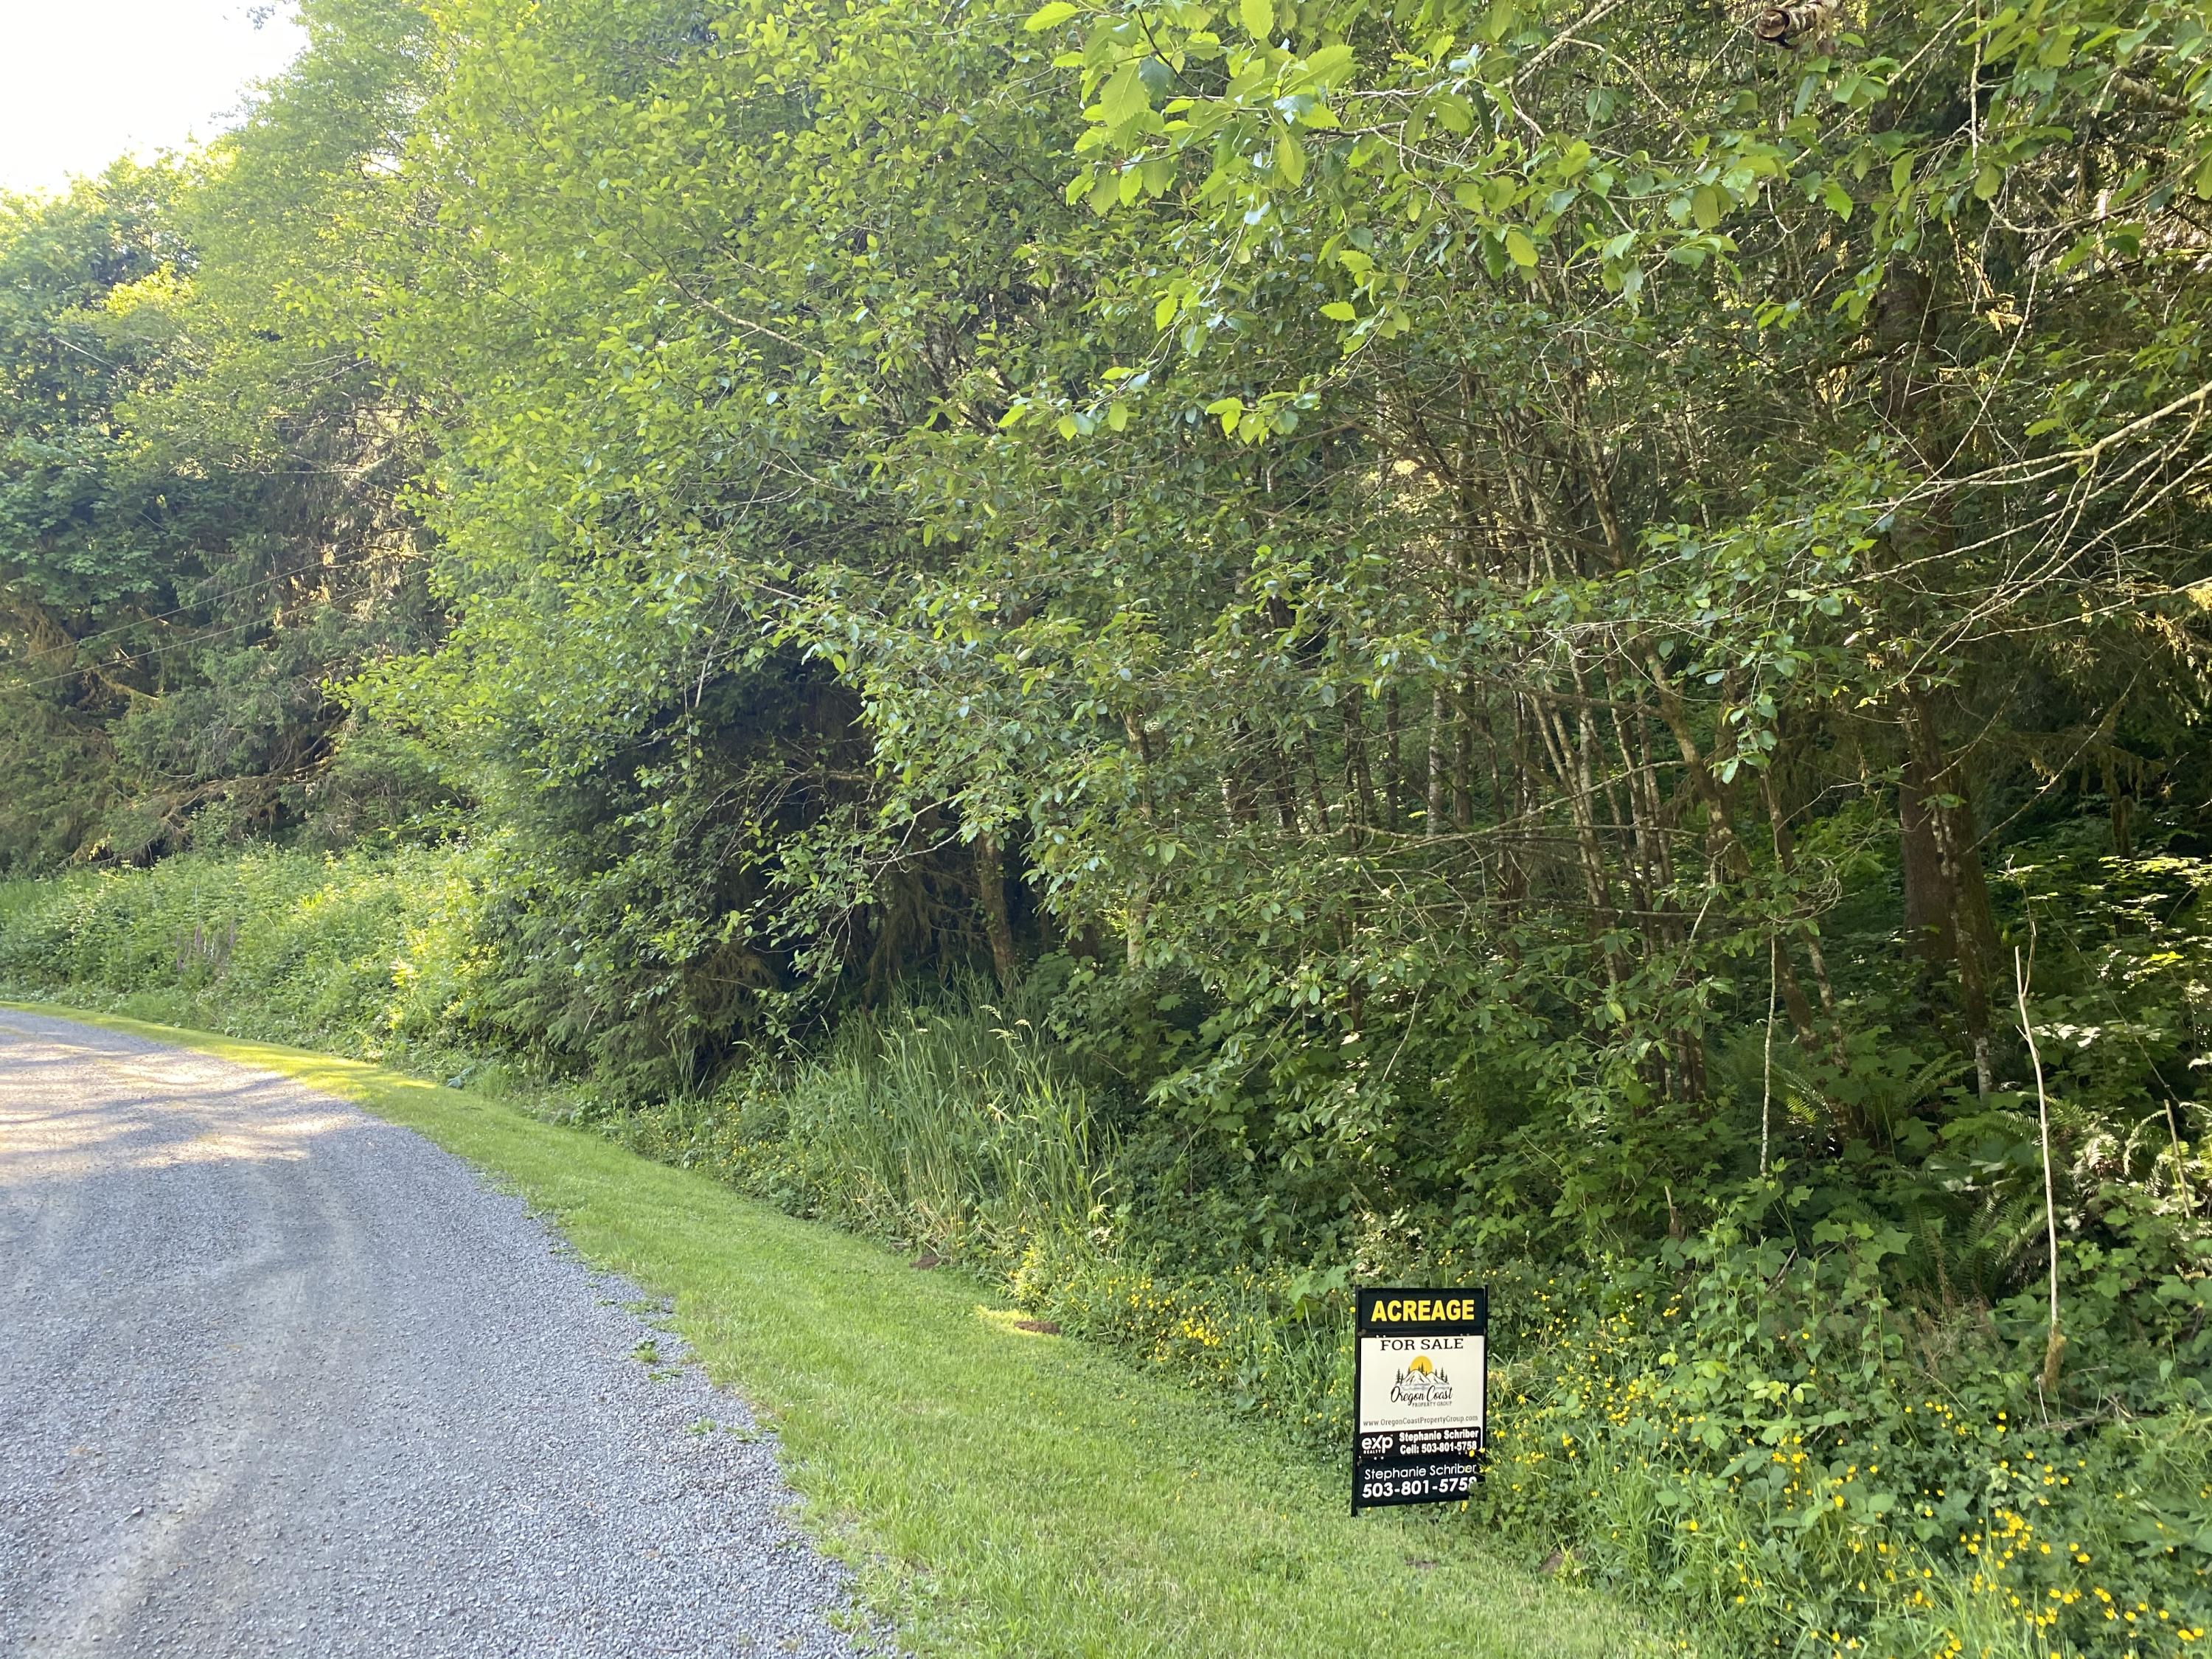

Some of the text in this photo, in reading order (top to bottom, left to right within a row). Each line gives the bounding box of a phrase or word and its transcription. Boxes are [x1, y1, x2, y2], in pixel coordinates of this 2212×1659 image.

[1371, 1300, 1475, 1322] ACREAGE
[1380, 1338, 1464, 1351] FOR SALE
[1391, 1385, 1453, 1406] Oregon Coast
[1363, 1415, 1478, 1427] www.OregonCoastPropertyGroup.com
[1399, 1429, 1479, 1443] Stephanie Schriber
[1399, 1441, 1478, 1455] Cell: 503-801-5758
[1364, 1463, 1477, 1481] Stephanie Schriber
